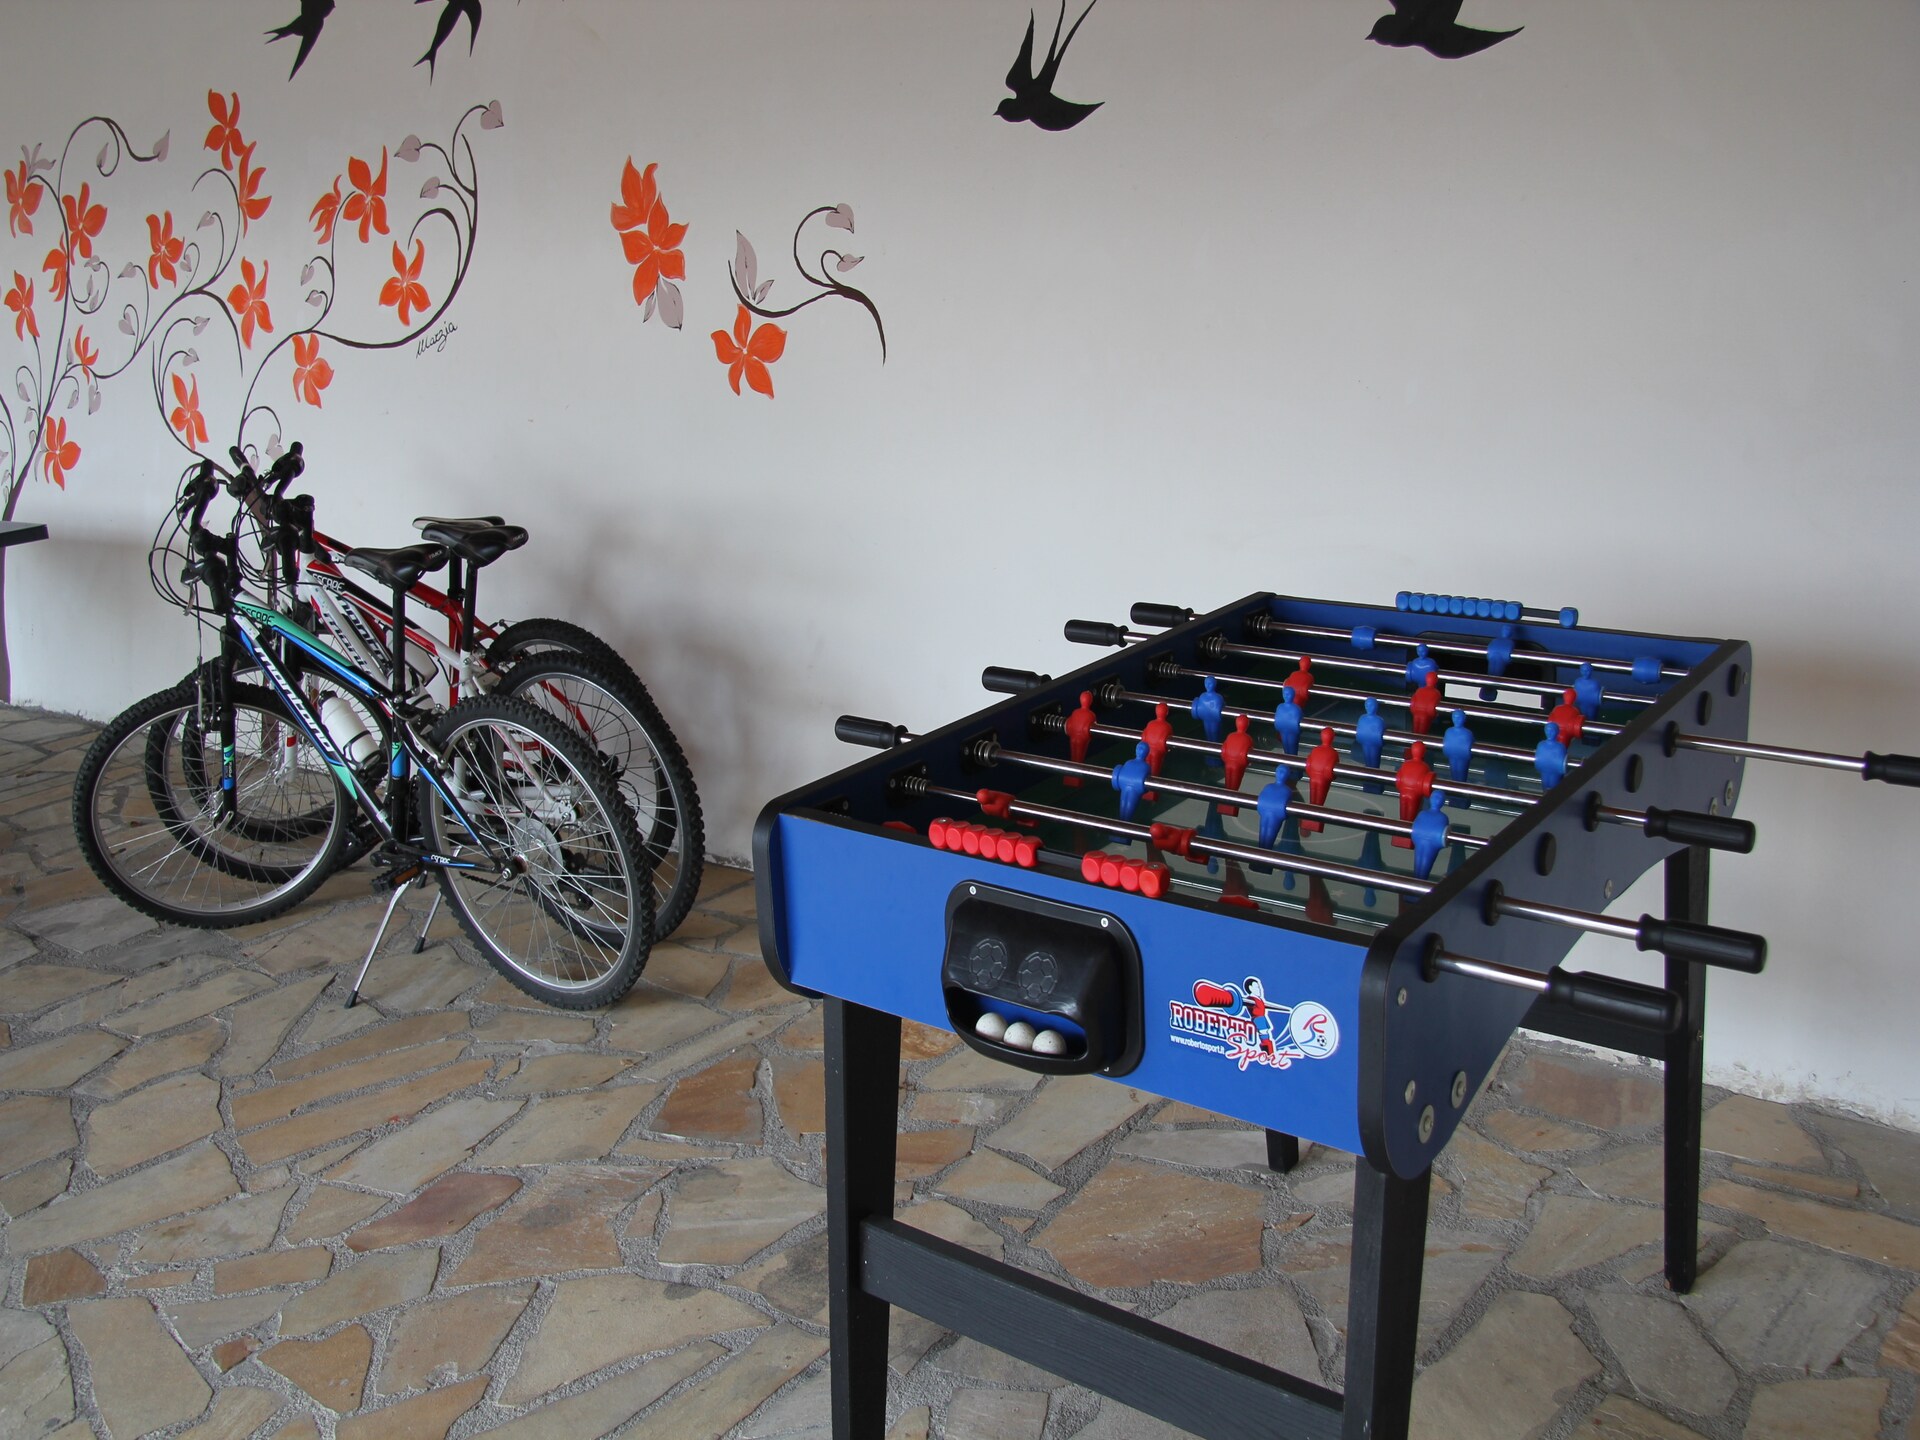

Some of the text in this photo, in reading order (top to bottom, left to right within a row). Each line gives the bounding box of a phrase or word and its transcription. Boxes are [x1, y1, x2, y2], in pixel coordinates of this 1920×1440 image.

[1169, 1001, 1259, 1047] ROBERTO
[1169, 1034, 1226, 1056] www.robertosport.it
[1226, 1033, 1301, 1069] Sport
